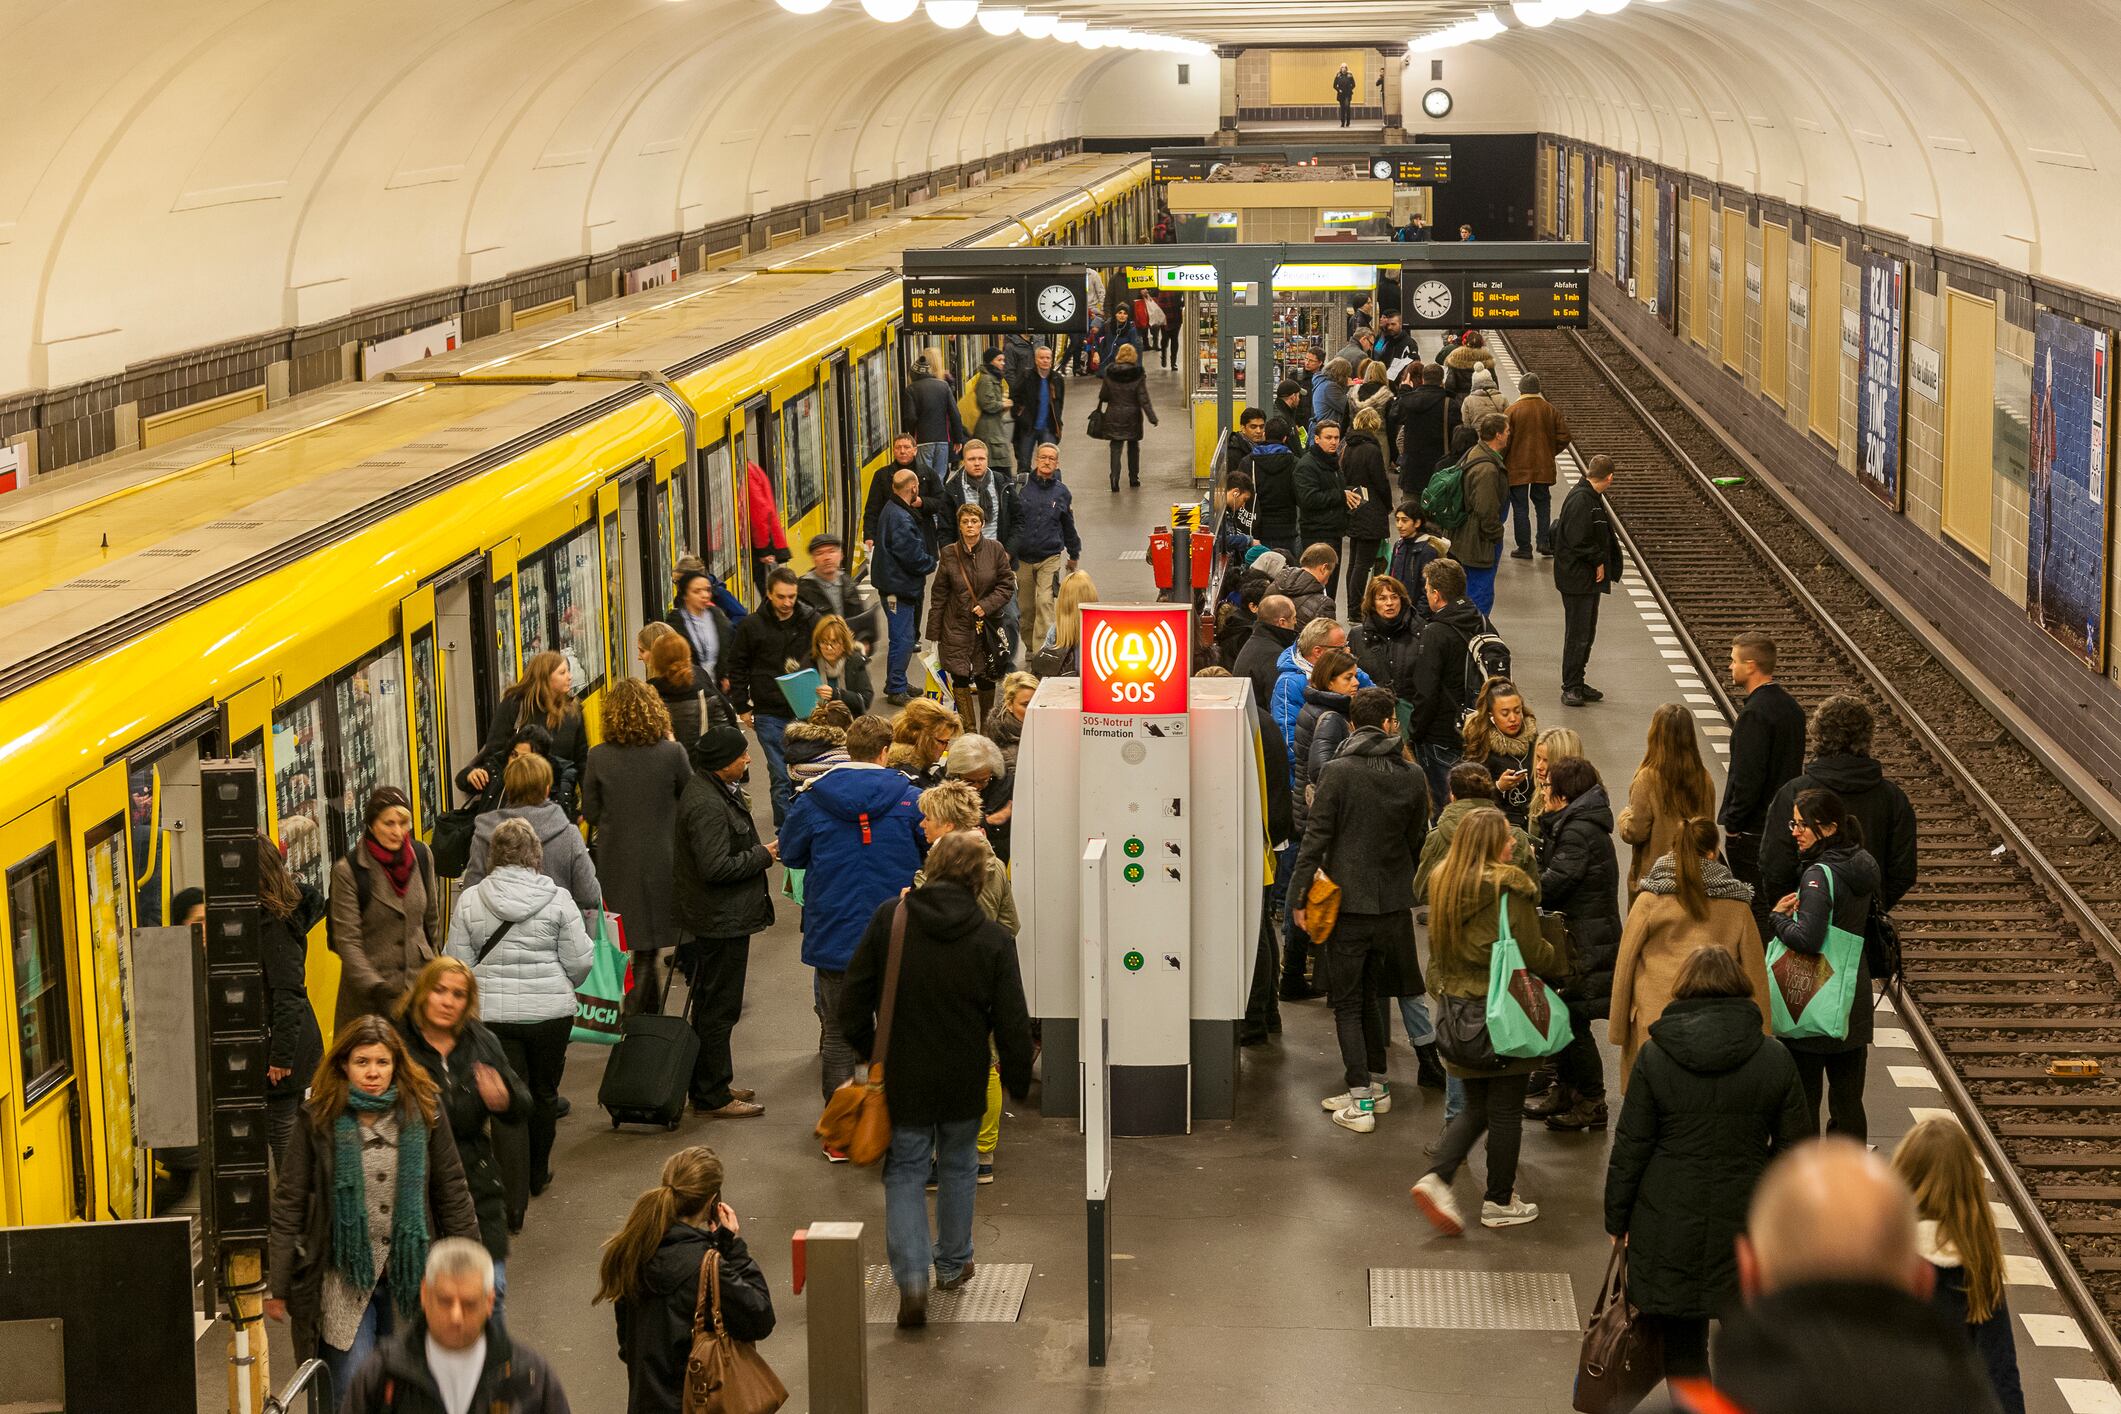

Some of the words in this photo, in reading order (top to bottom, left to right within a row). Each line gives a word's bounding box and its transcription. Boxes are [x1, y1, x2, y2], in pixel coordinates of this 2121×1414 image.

[1179, 271, 1210, 281] Presse
[1553, 281, 1578, 289] Abfahrt
[1629, 281, 1635, 293] 4
[1472, 291, 1484, 302] U6
[1489, 293, 1520, 302] Alt-Tegel
[1869, 265, 1890, 321] REAL
[912, 297, 924, 308] U6
[1650, 299, 1656, 313] 2
[912, 312, 924, 323] U6
[991, 314, 999, 322] in
[1472, 307, 1484, 318] U6
[1489, 308, 1520, 317] Alt-Tegel
[1869, 315, 1890, 357] PEOPLE
[1868, 379, 1888, 441] TIME
[1866, 432, 1886, 484] ZONE
[1111, 681, 1156, 703] SOS
[1083, 716, 1133, 727] SOS-Notruf
[1083, 728, 1134, 738] Information
